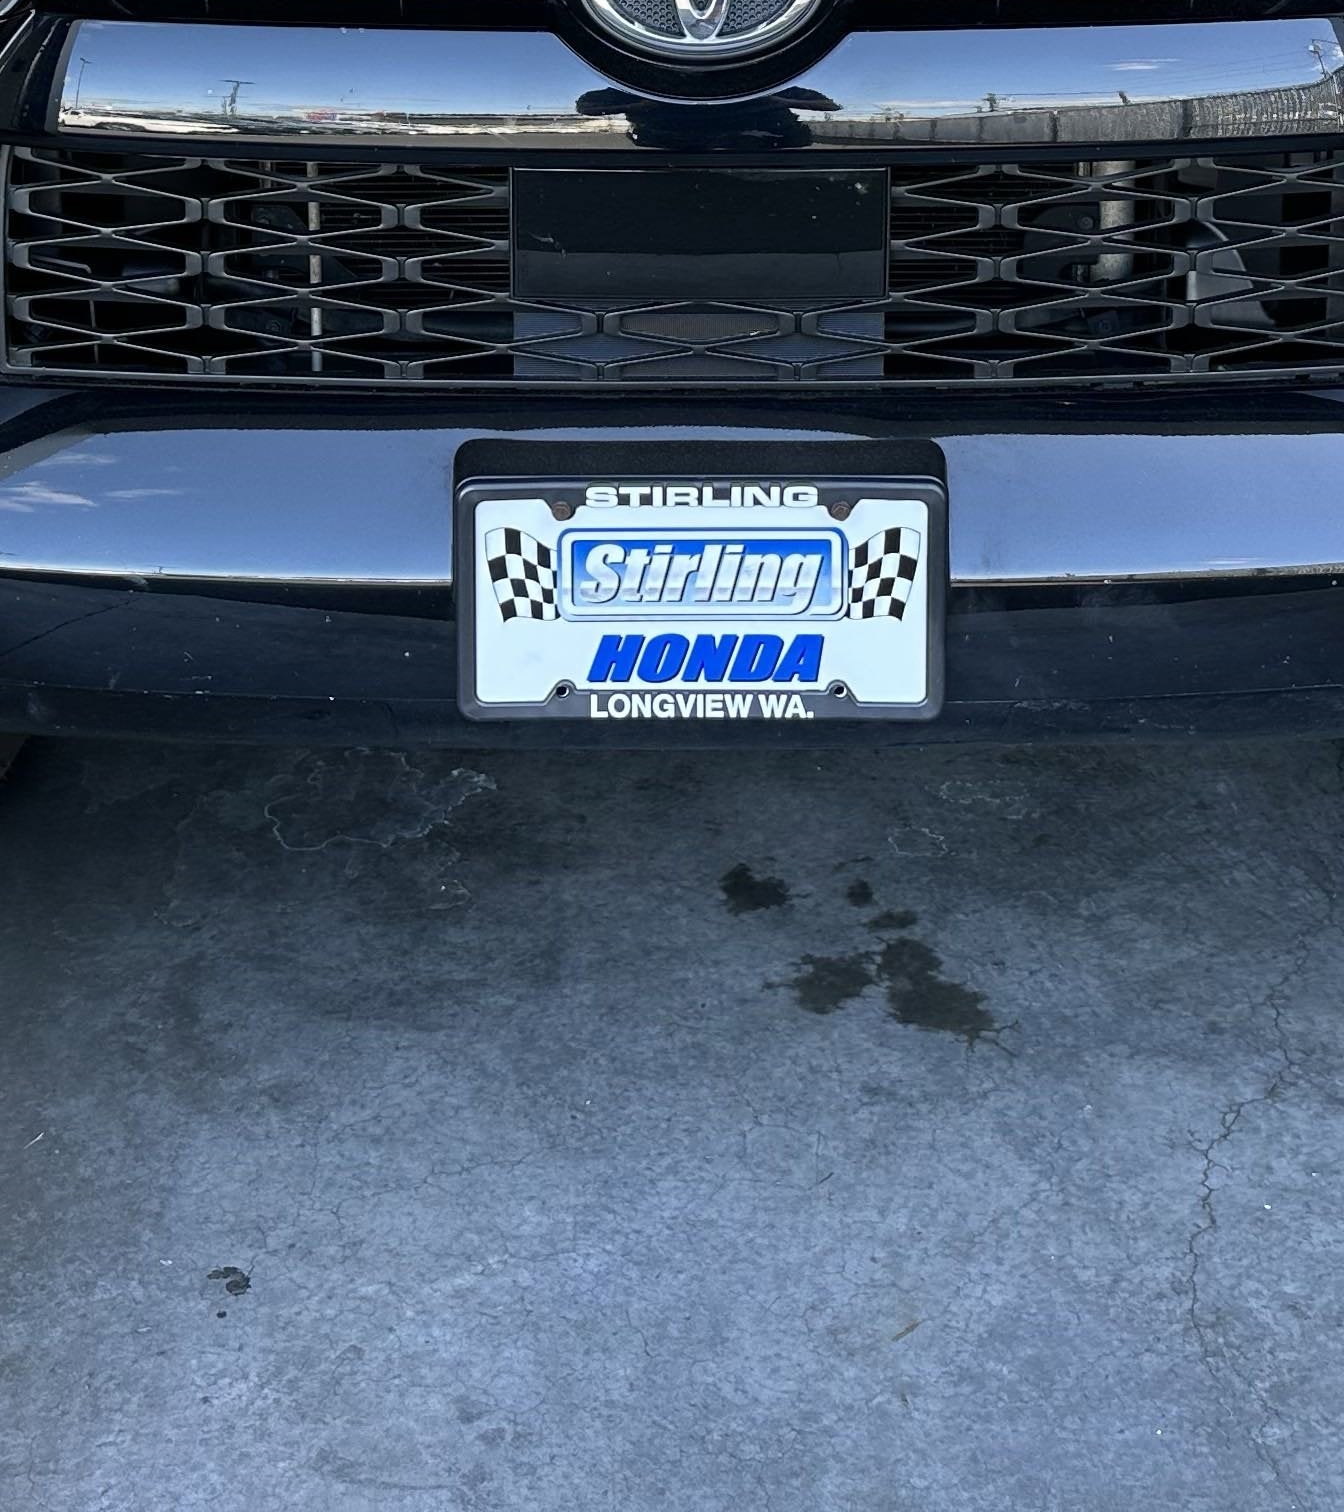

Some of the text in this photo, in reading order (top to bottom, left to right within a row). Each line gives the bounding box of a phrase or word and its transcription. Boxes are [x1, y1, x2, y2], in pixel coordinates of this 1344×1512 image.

[585, 486, 819, 508] STIRLING
[580, 543, 824, 614] Stirling
[586, 633, 825, 683] HONDA
[589, 693, 815, 719] LONGVIEW WA.
